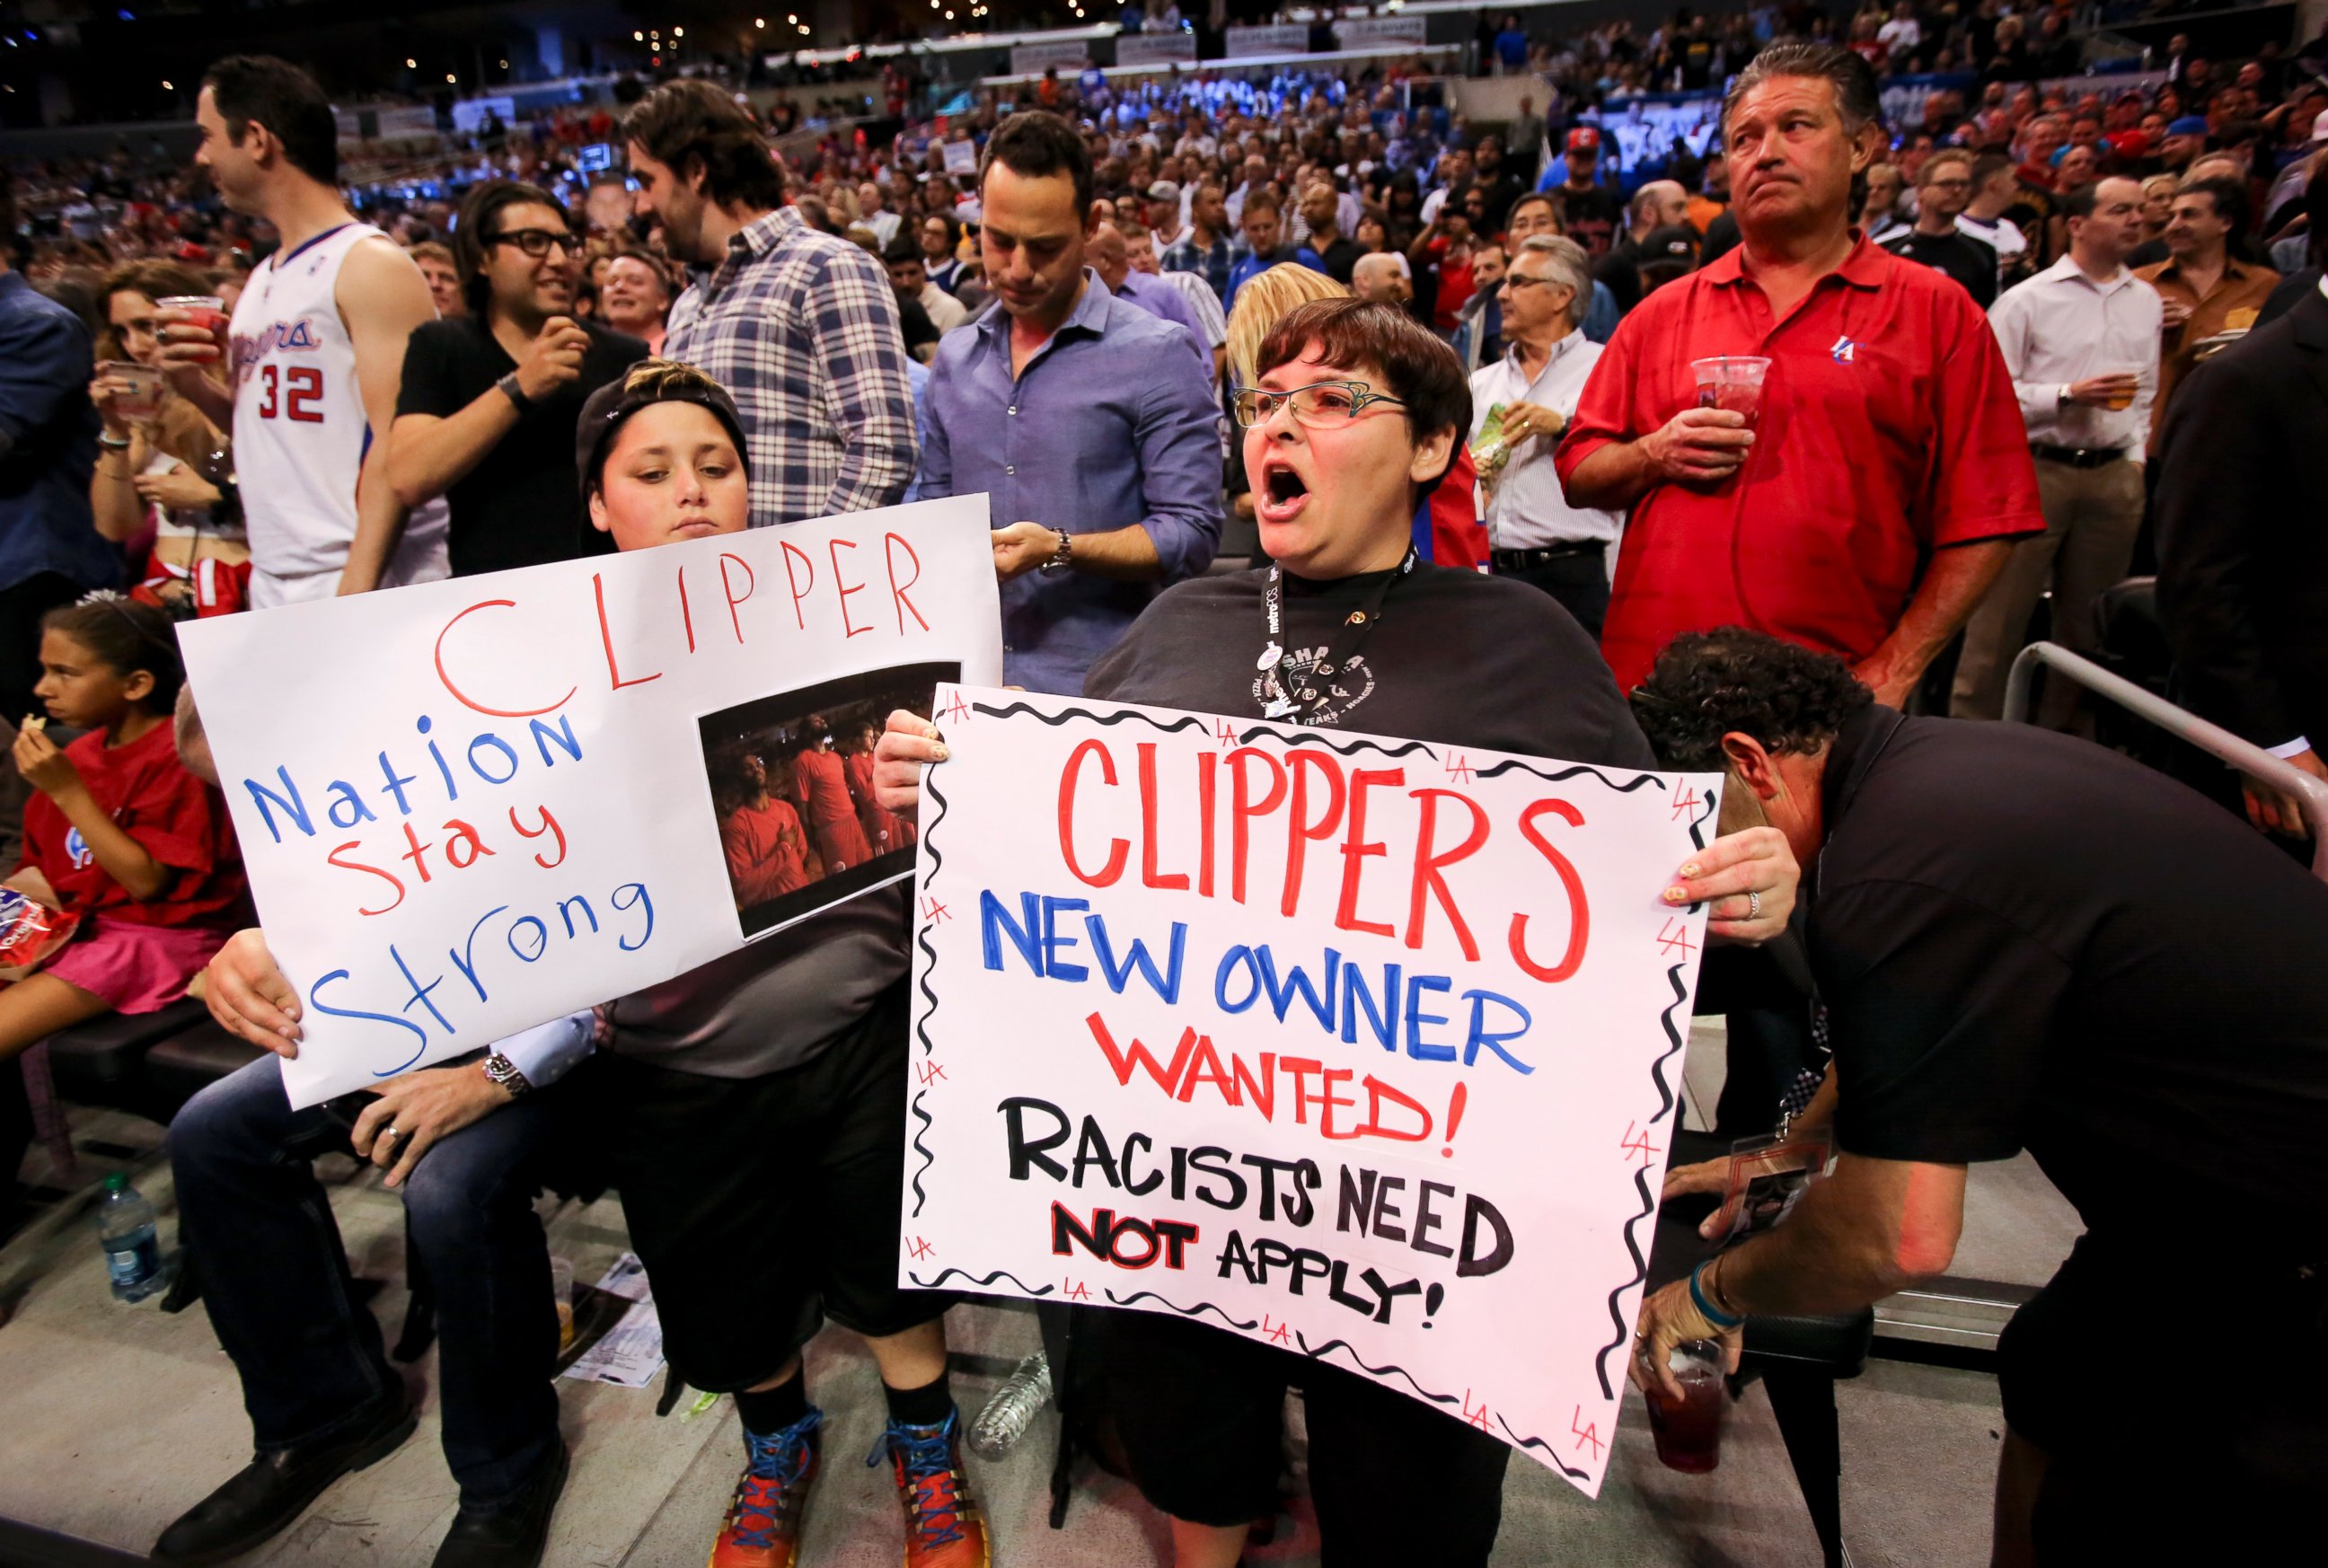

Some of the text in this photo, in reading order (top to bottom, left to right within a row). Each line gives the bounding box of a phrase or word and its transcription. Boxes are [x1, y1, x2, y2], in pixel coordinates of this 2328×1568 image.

[260, 365, 324, 423] 32
[435, 532, 930, 718] CLIPPER
[327, 805, 568, 917] Stay
[1057, 736, 1591, 984] CLIPPERS
[309, 882, 655, 1079] Strong
[980, 889, 1535, 1076] NEW OWNER
[1085, 1011, 1468, 1159] WANTED!
[997, 1096, 1515, 1279] RACISTS NEED
[1050, 1199, 1445, 1329] NOT APPLY!
